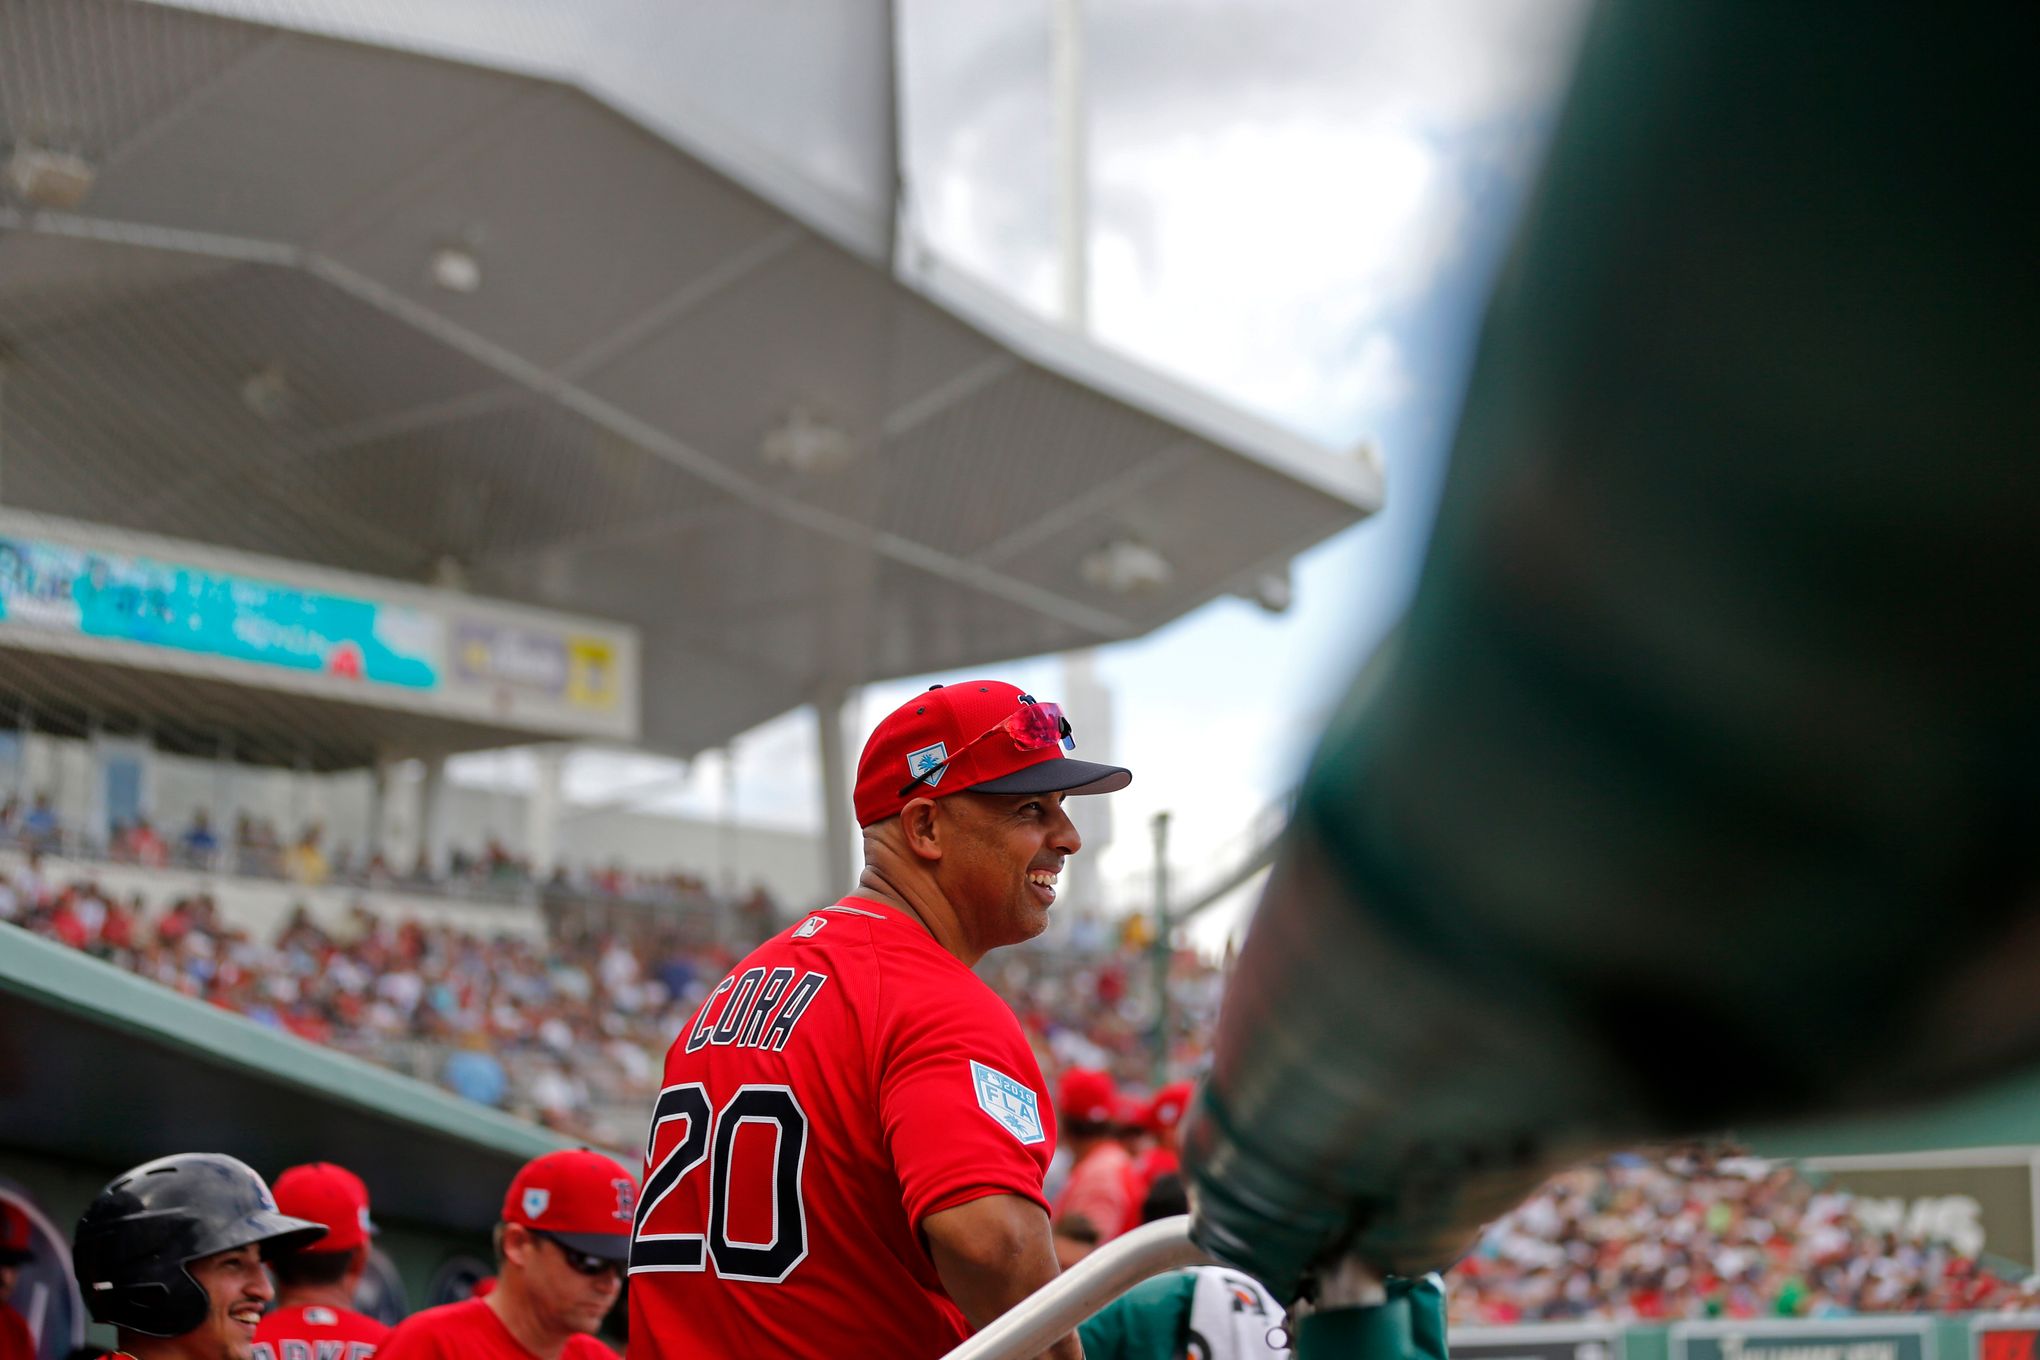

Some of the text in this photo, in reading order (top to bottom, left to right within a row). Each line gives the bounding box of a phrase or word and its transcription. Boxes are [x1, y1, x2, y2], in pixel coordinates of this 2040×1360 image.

[685, 966, 828, 1054] CORA
[985, 1084, 1034, 1124] FLA
[1003, 1081, 1033, 1104] 2019
[628, 1082, 808, 1284] 20
